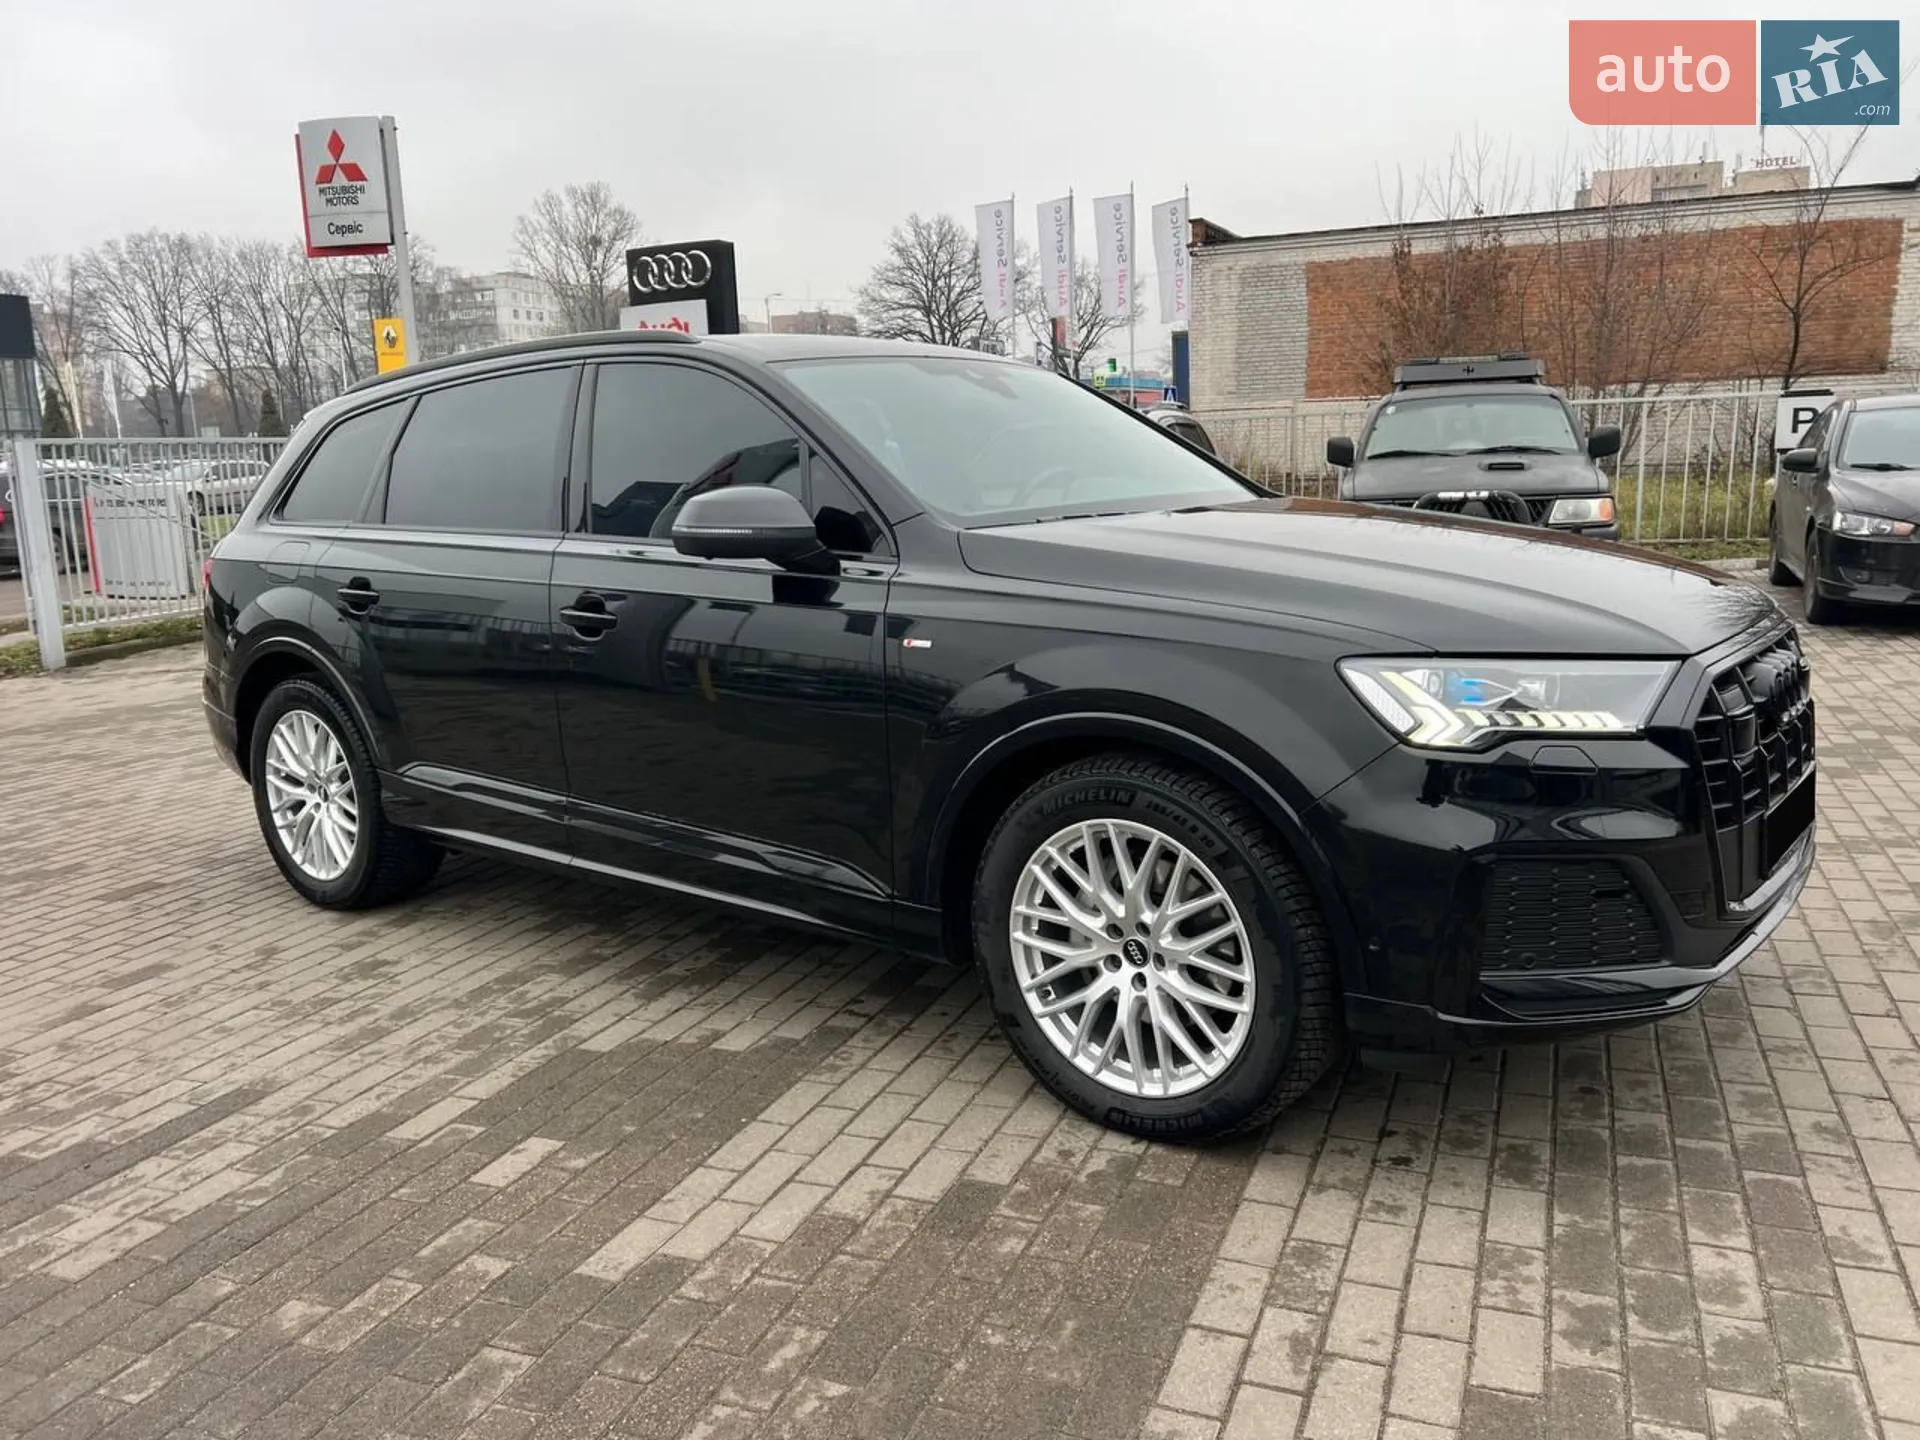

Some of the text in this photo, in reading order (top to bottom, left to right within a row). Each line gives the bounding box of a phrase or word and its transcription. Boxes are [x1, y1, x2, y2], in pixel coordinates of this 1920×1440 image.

[1755, 156, 1797, 168] HOTEL
[318, 185, 366, 197] MITSUBISHI
[325, 195, 360, 207] MOTORS
[327, 221, 364, 237] Сервіс
[1791, 407, 1819, 434] P
[1042, 788, 1131, 815] MICHELIN
[1108, 1111, 1202, 1131] MICHELIN
